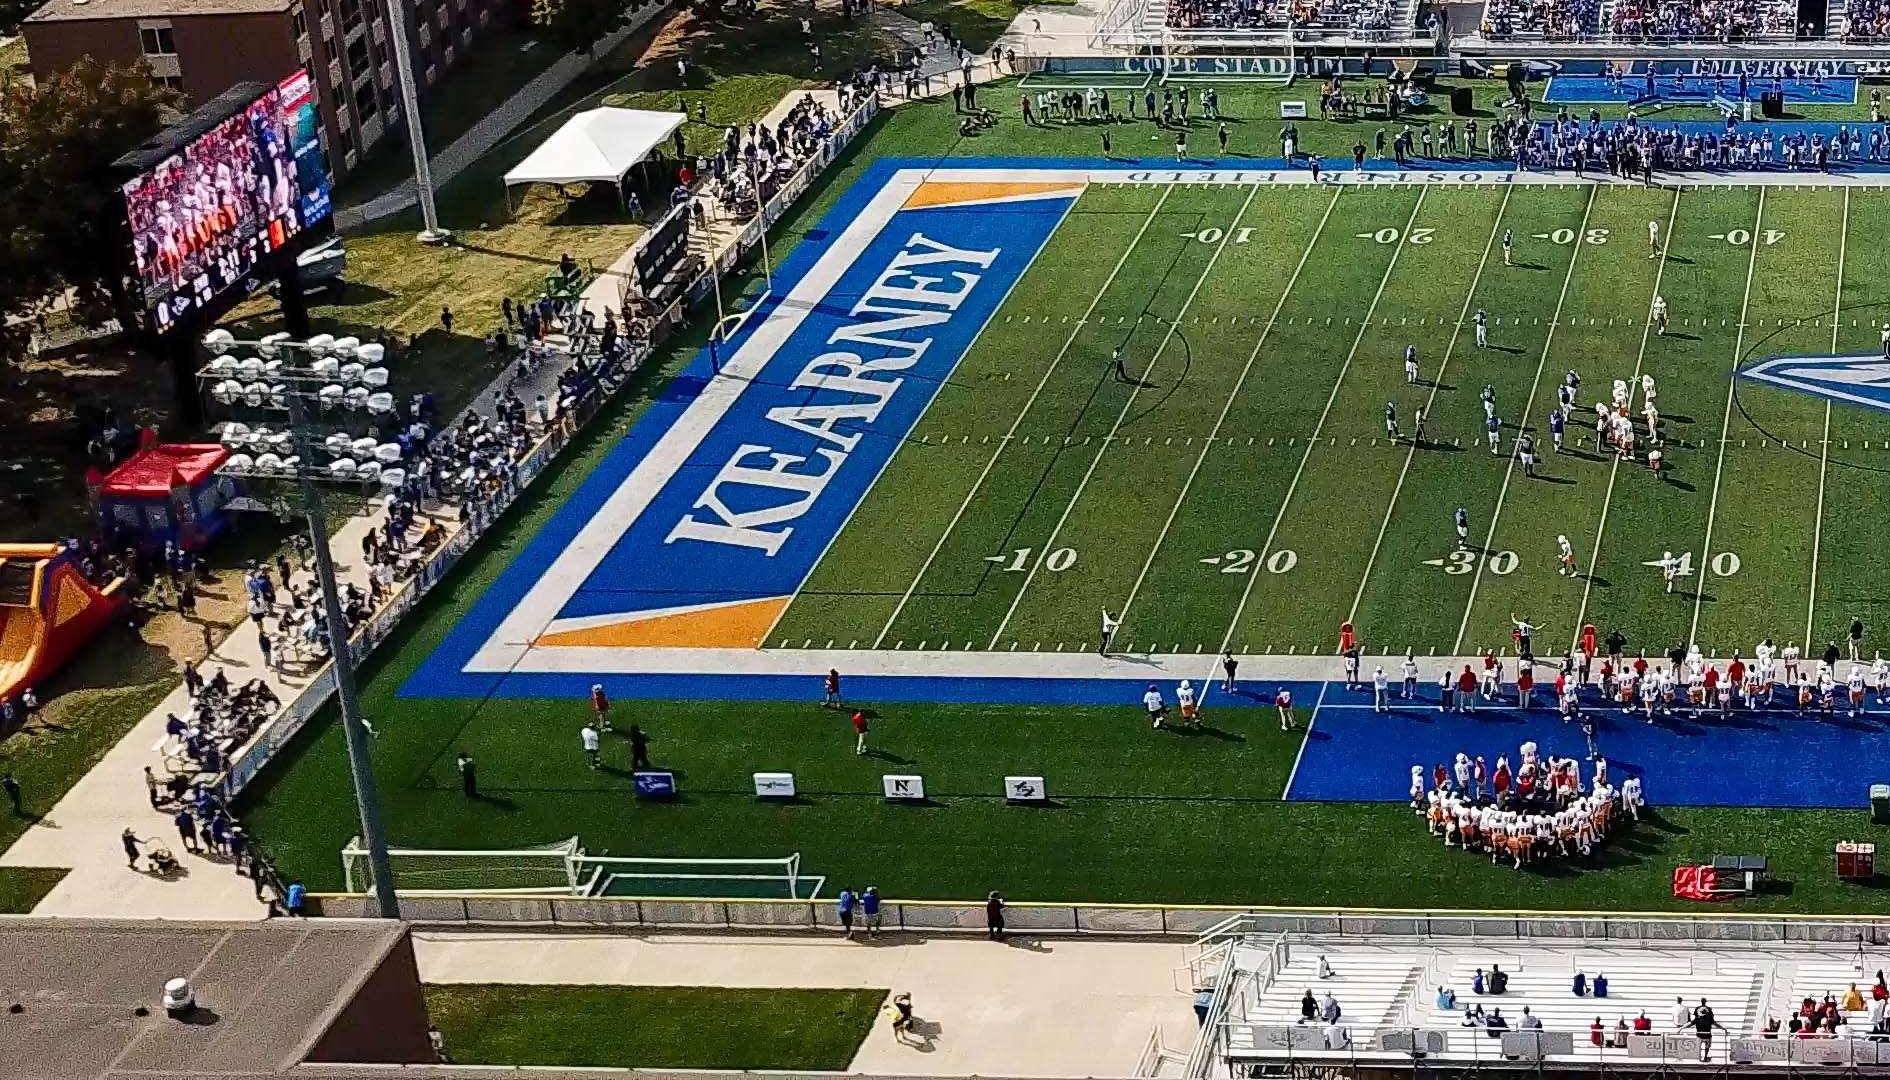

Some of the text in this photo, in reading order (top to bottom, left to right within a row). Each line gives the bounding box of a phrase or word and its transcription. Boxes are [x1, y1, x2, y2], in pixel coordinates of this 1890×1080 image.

[1124, 58, 1345, 74] COPE STADUM
[1127, 171, 1281, 182] FIELD
[1197, 227, 1257, 244] 10
[1376, 227, 1434, 244] 20
[1550, 228, 1609, 245] 30
[1728, 228, 1786, 245] 40
[664, 233, 1001, 557] KEARNEY
[1002, 548, 1078, 572] 10
[1220, 549, 1298, 574] 20
[1443, 550, 1520, 575] 30
[1655, 552, 1741, 576] 40
